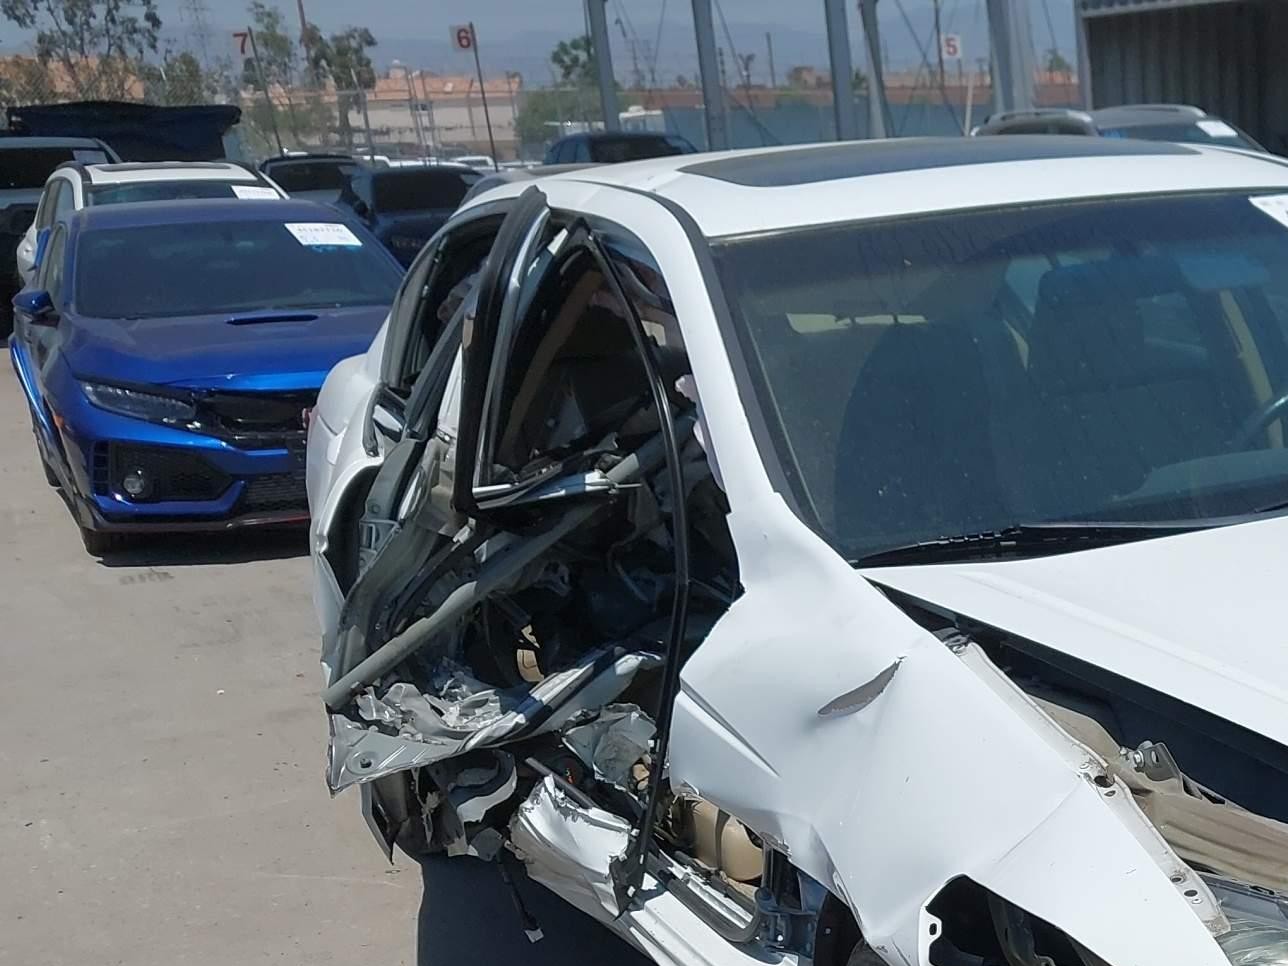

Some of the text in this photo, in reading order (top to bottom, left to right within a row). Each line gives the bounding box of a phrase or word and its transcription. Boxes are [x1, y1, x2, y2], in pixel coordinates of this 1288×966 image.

[232, 32, 248, 55] 7
[457, 28, 471, 49] 6
[945, 36, 958, 57] 5
